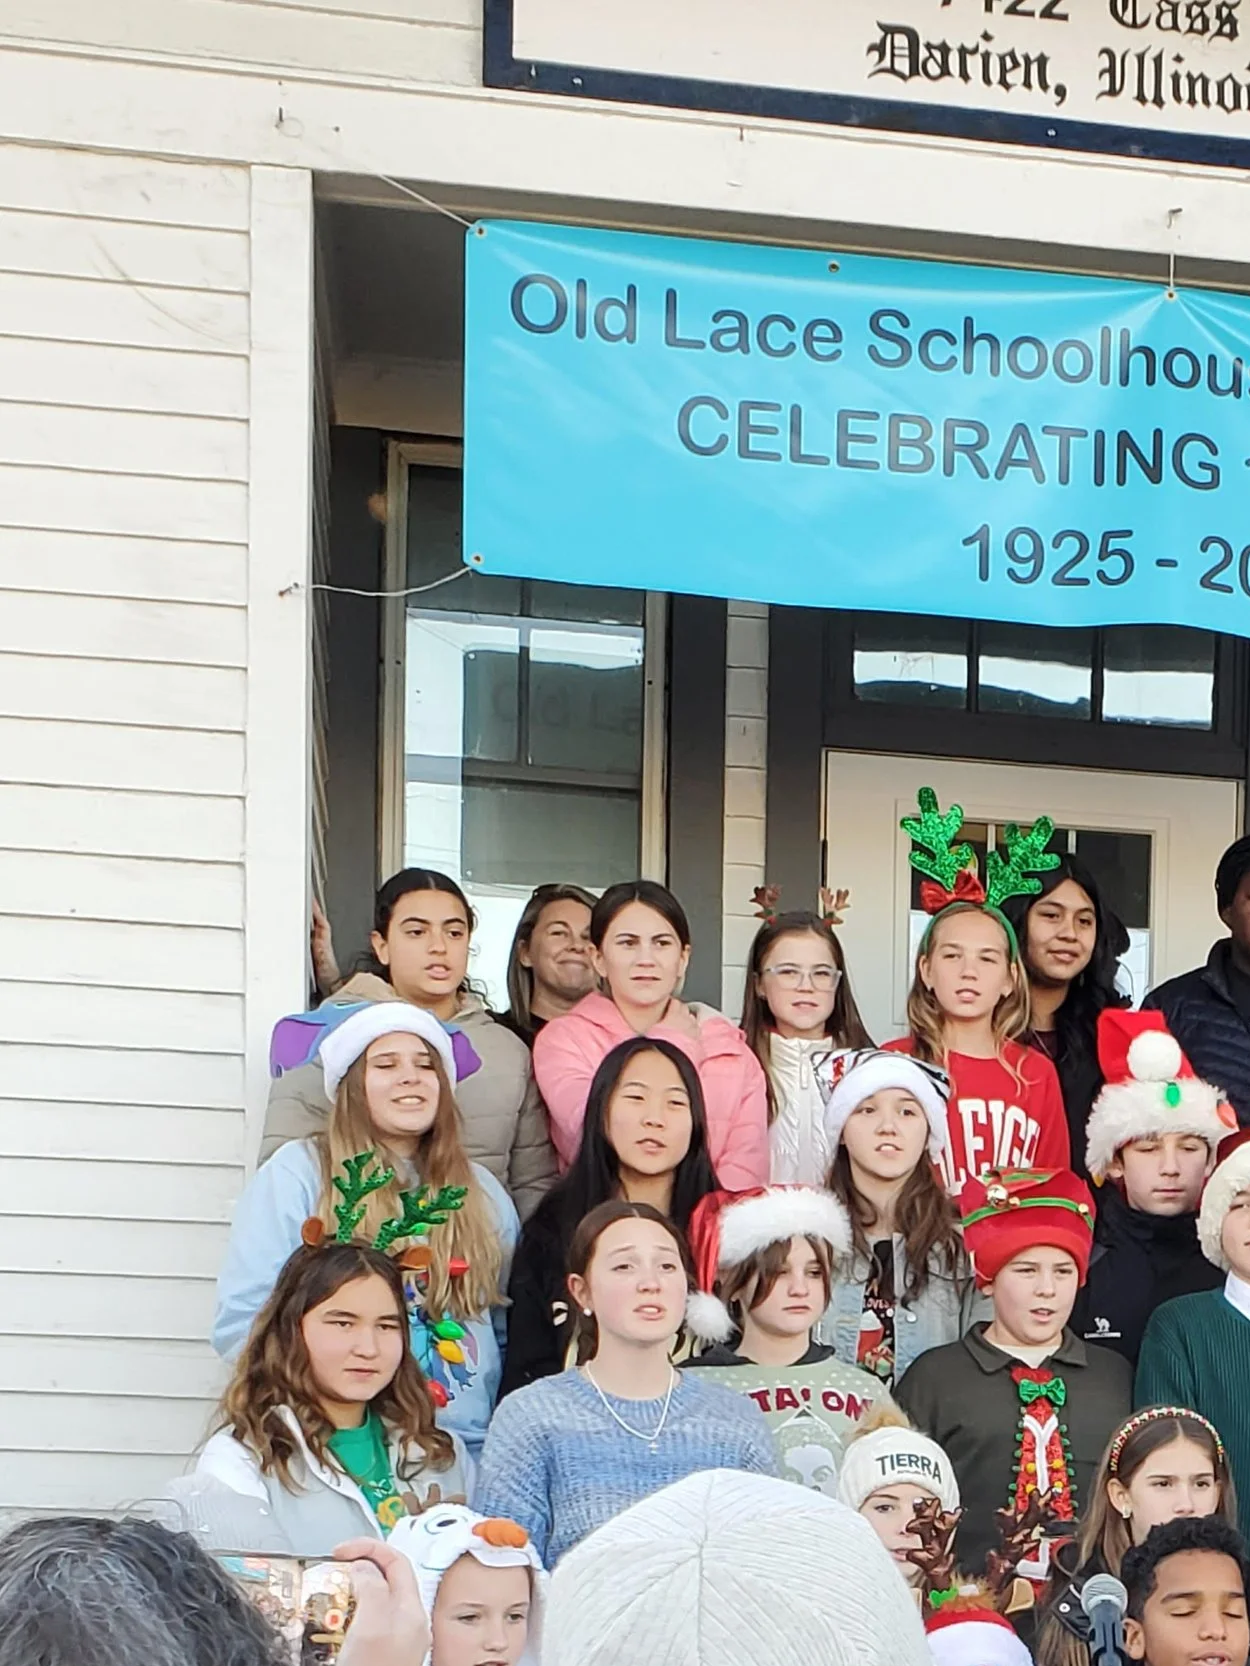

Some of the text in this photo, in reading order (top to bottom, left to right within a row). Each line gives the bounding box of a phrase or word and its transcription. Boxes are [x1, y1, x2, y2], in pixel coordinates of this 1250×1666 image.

[1109, 0, 1240, 42] Cass
[866, 20, 1068, 106] Darien,
[510, 273, 638, 345] Old
[665, 288, 844, 362] Lace
[677, 395, 1221, 491] CELEBRATING
[961, 523, 1135, 587] 1925
[875, 1453, 942, 1484] TIERRA
